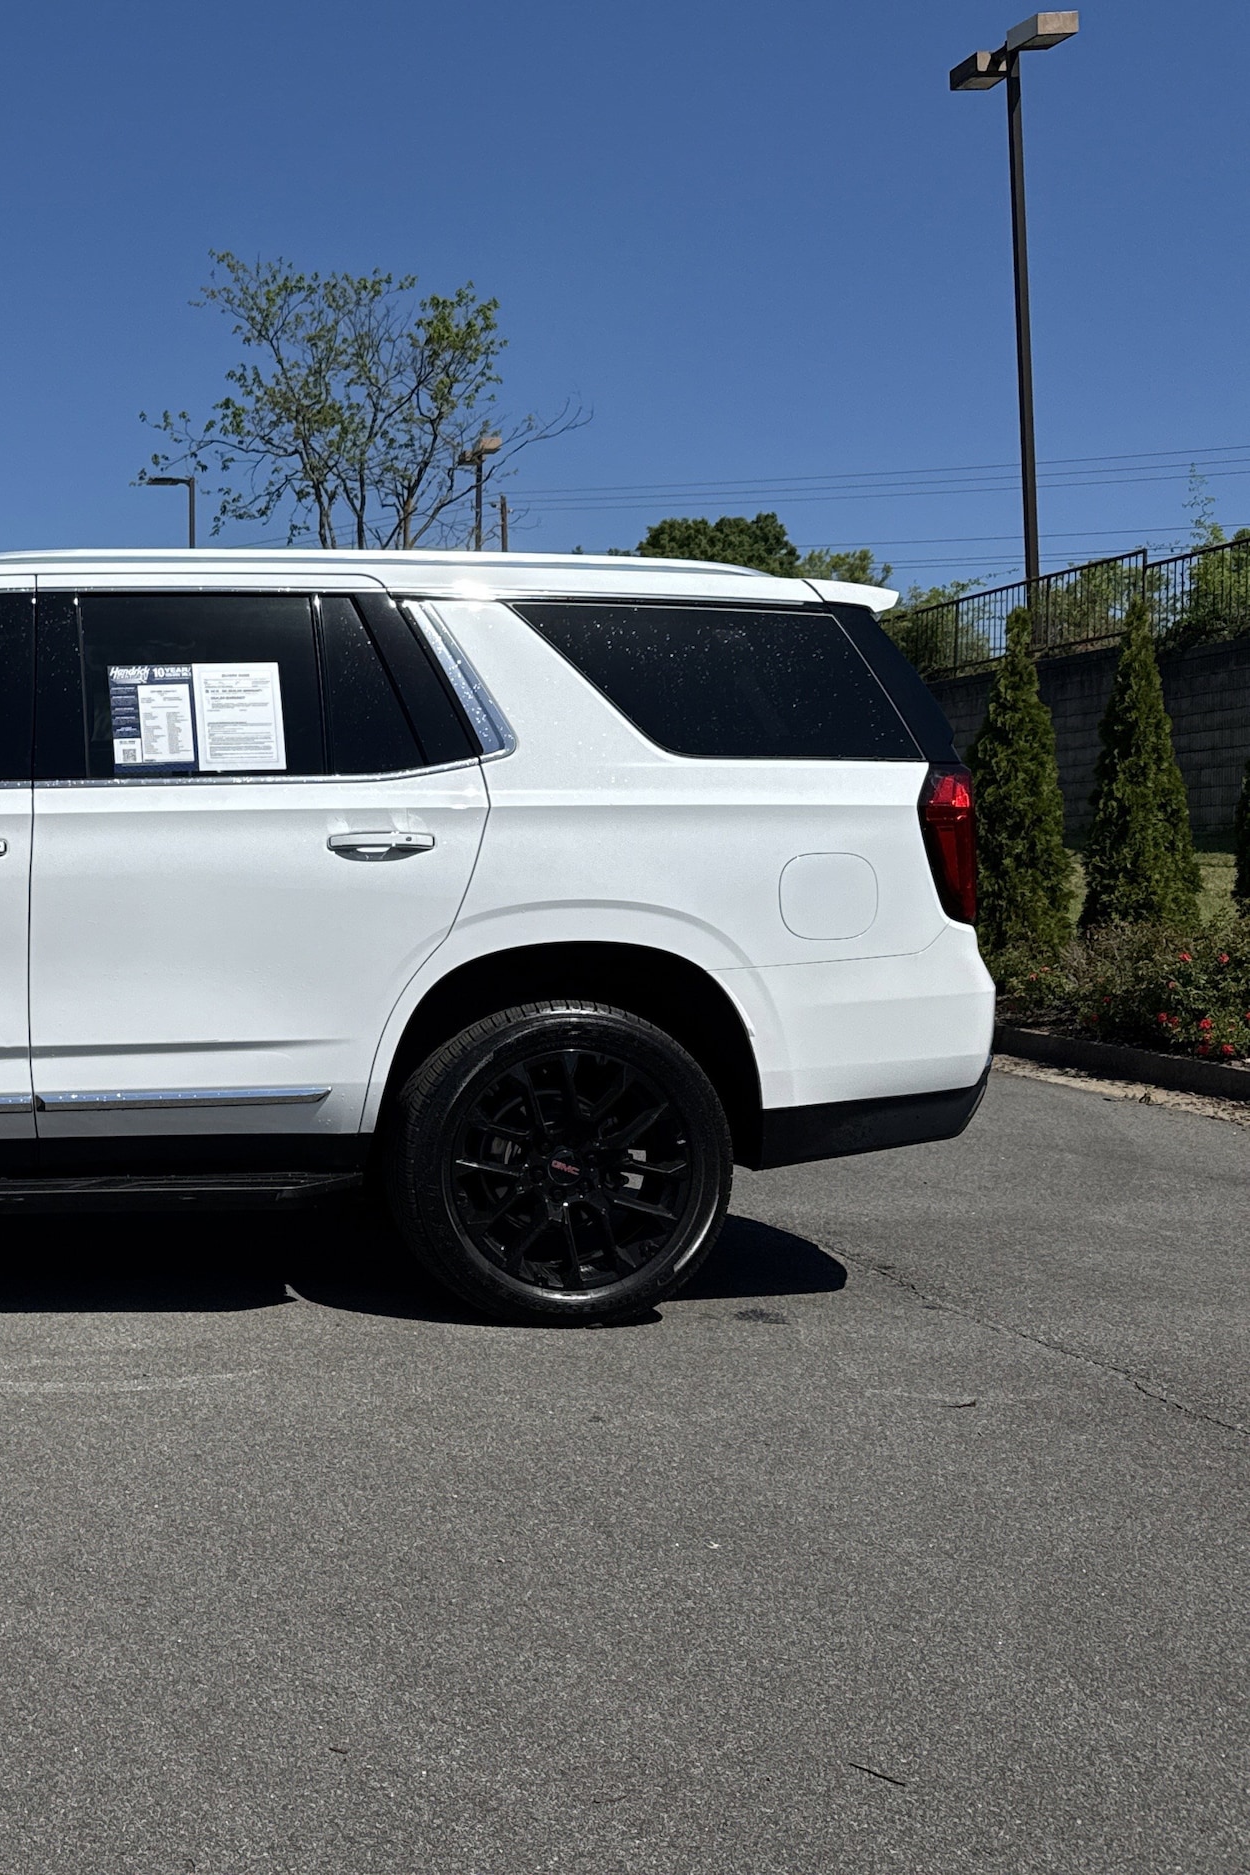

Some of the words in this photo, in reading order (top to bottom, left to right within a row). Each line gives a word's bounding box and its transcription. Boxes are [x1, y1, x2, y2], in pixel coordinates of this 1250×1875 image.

[110, 666, 150, 680] Hendrick
[152, 667, 165, 678] 10
[551, 1159, 580, 1176] GMC
